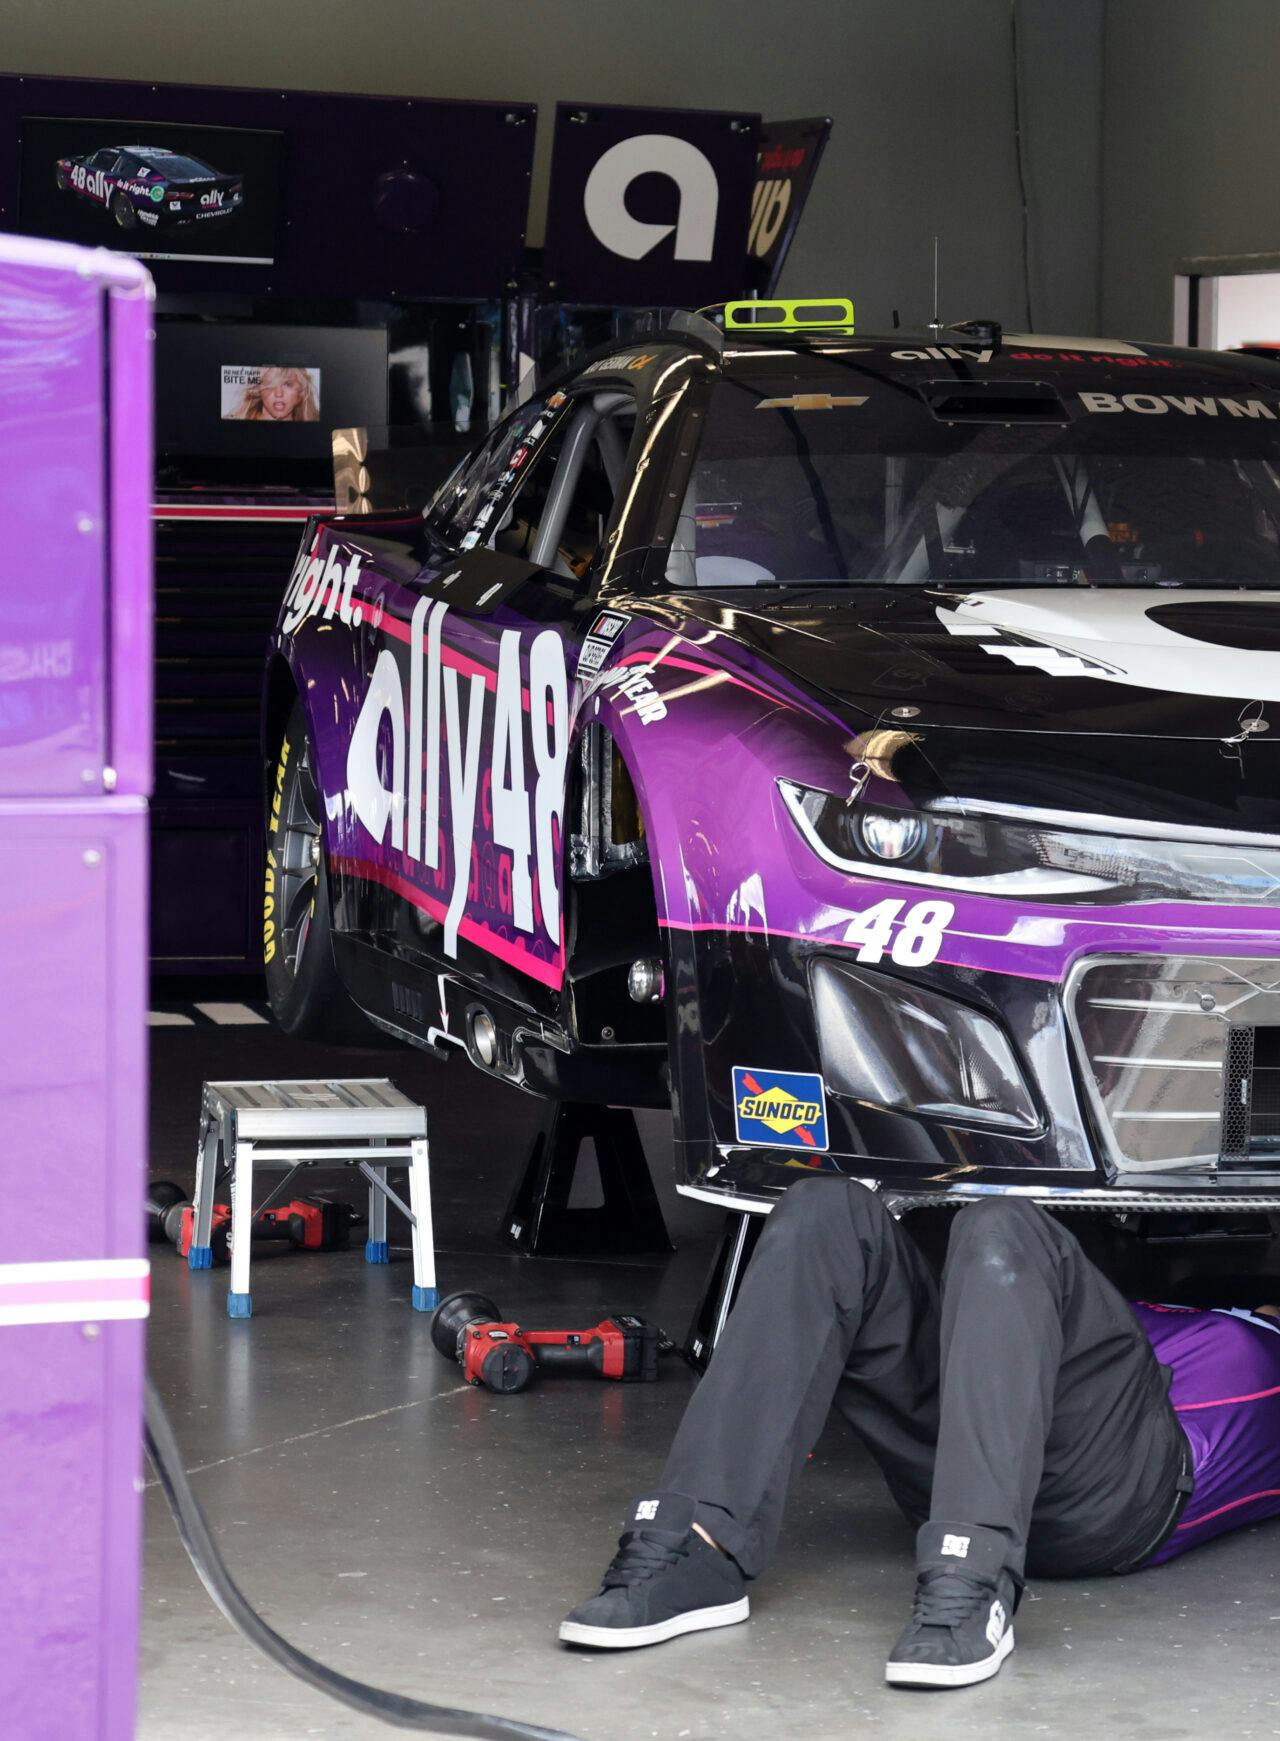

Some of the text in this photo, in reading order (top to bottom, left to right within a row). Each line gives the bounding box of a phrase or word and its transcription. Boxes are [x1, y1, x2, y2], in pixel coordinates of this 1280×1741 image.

[70, 164, 86, 187] 48
[86, 170, 114, 207] ally
[200, 189, 224, 206] ally
[890, 347, 993, 363] ally
[223, 375, 261, 385] BITE ME
[346, 594, 569, 960] ally 48
[842, 898, 956, 968] 48
[742, 1099, 817, 1122] SUNOCO
